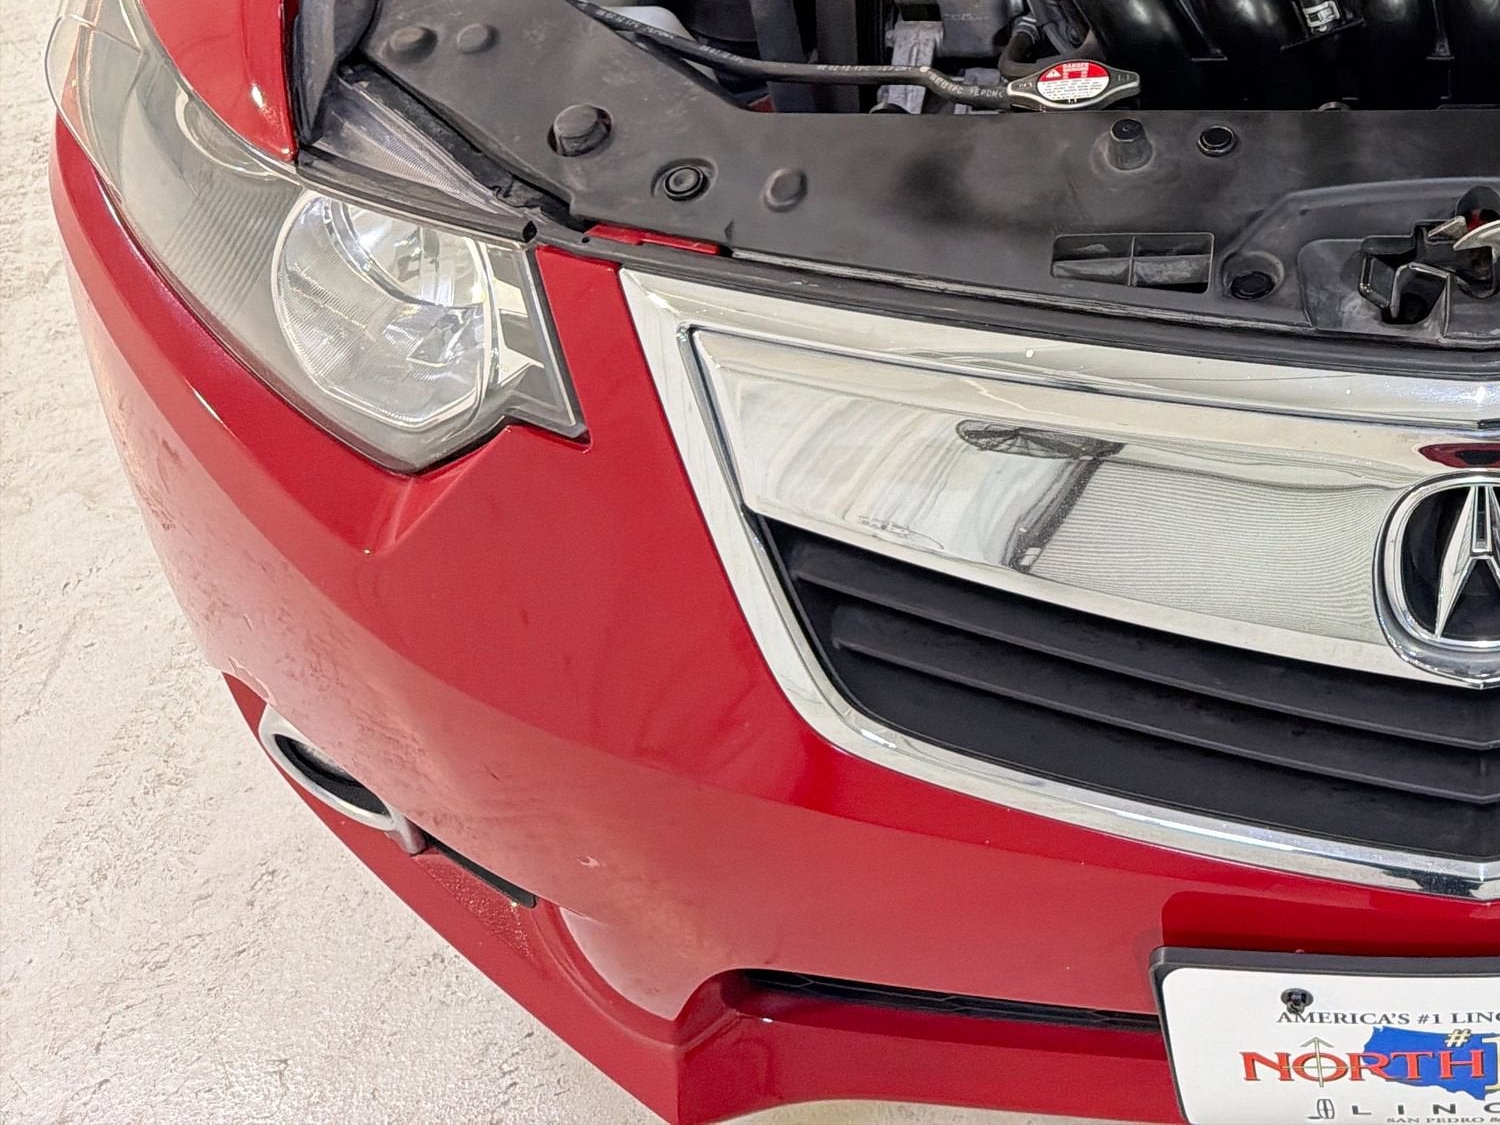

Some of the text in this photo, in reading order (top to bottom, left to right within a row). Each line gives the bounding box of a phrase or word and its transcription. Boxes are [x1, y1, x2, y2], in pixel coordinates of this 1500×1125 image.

[1276, 1011, 1410, 1025] AMERICA'S
[1416, 1012, 1442, 1024] #1
[1239, 1049, 1486, 1082] NORTH
[1386, 1116, 1420, 1124] SAN
[1426, 1115, 1485, 1124] PEDRO
